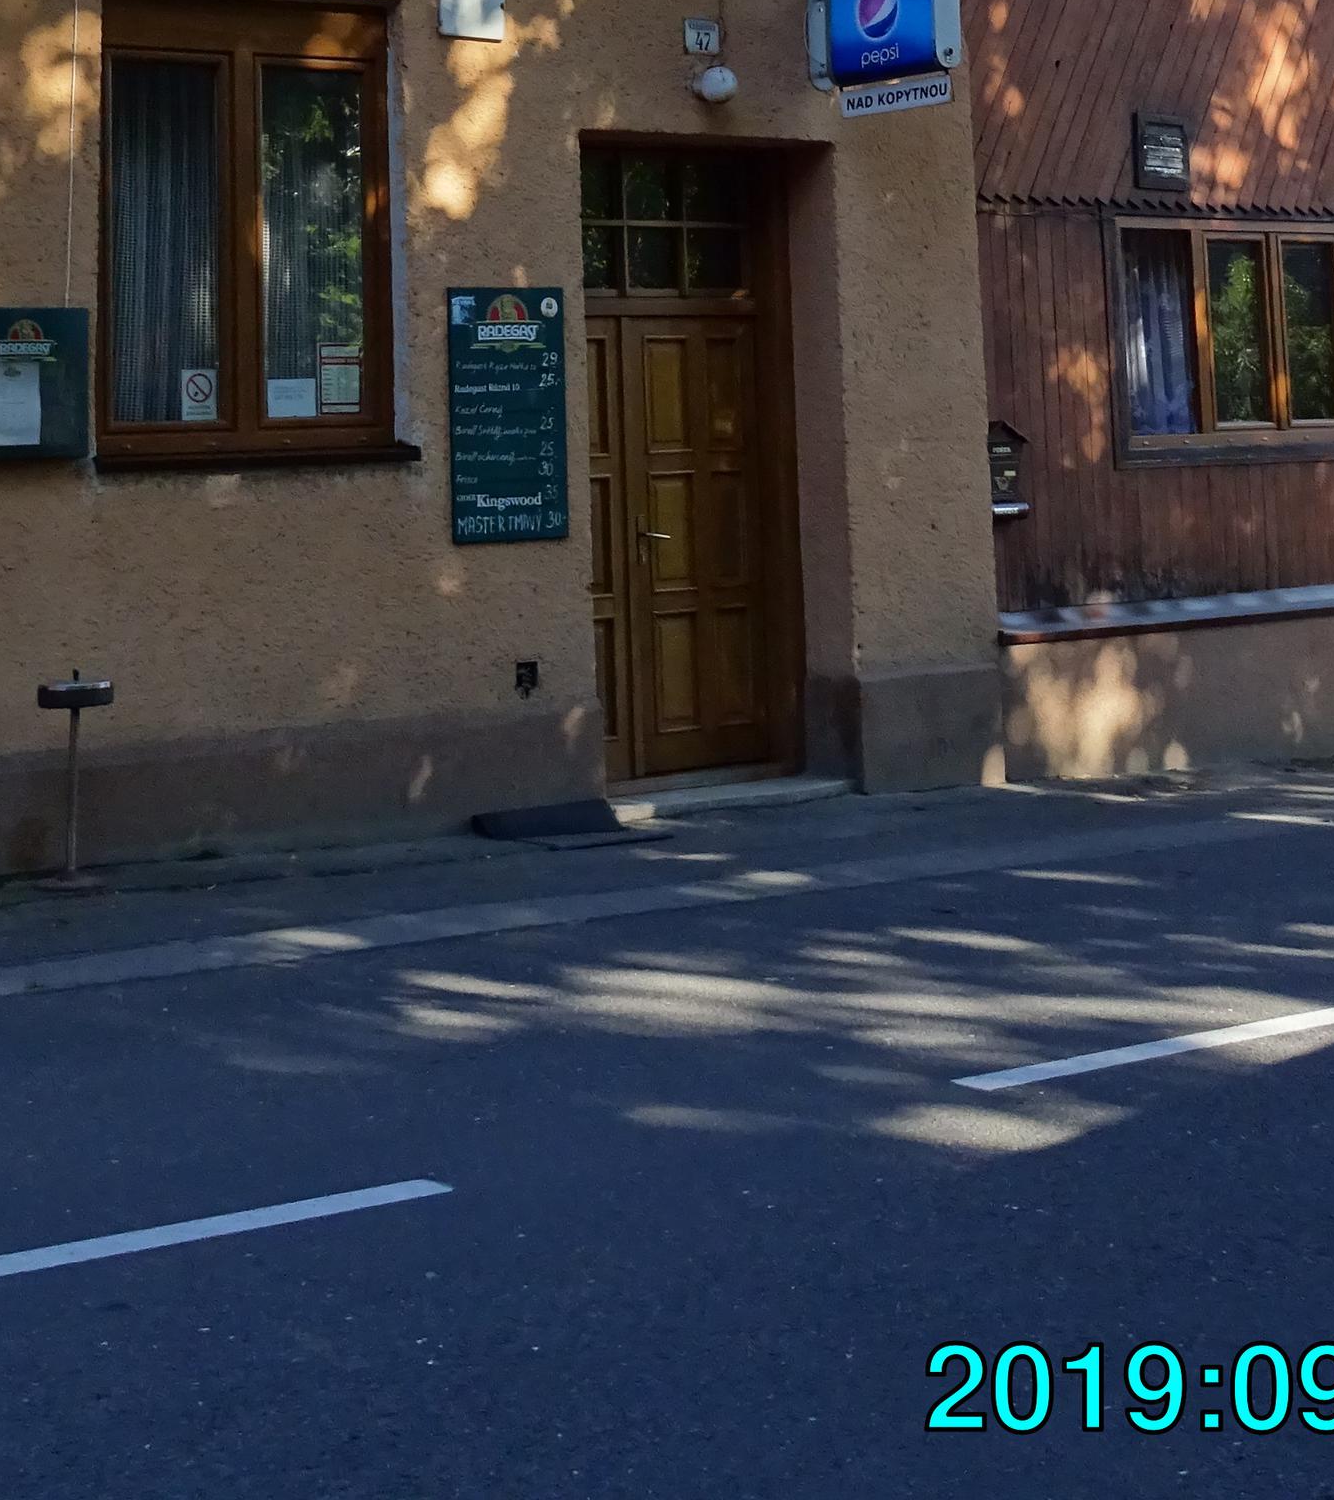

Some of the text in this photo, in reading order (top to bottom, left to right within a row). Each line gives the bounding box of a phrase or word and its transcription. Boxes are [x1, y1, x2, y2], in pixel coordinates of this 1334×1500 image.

[695, 31, 711, 51] 47
[860, 42, 900, 68] pepsi
[845, 83, 949, 111] NAD KOPYTNOU
[477, 325, 540, 341] RADEGAST
[476, 492, 543, 511] Kingswood
